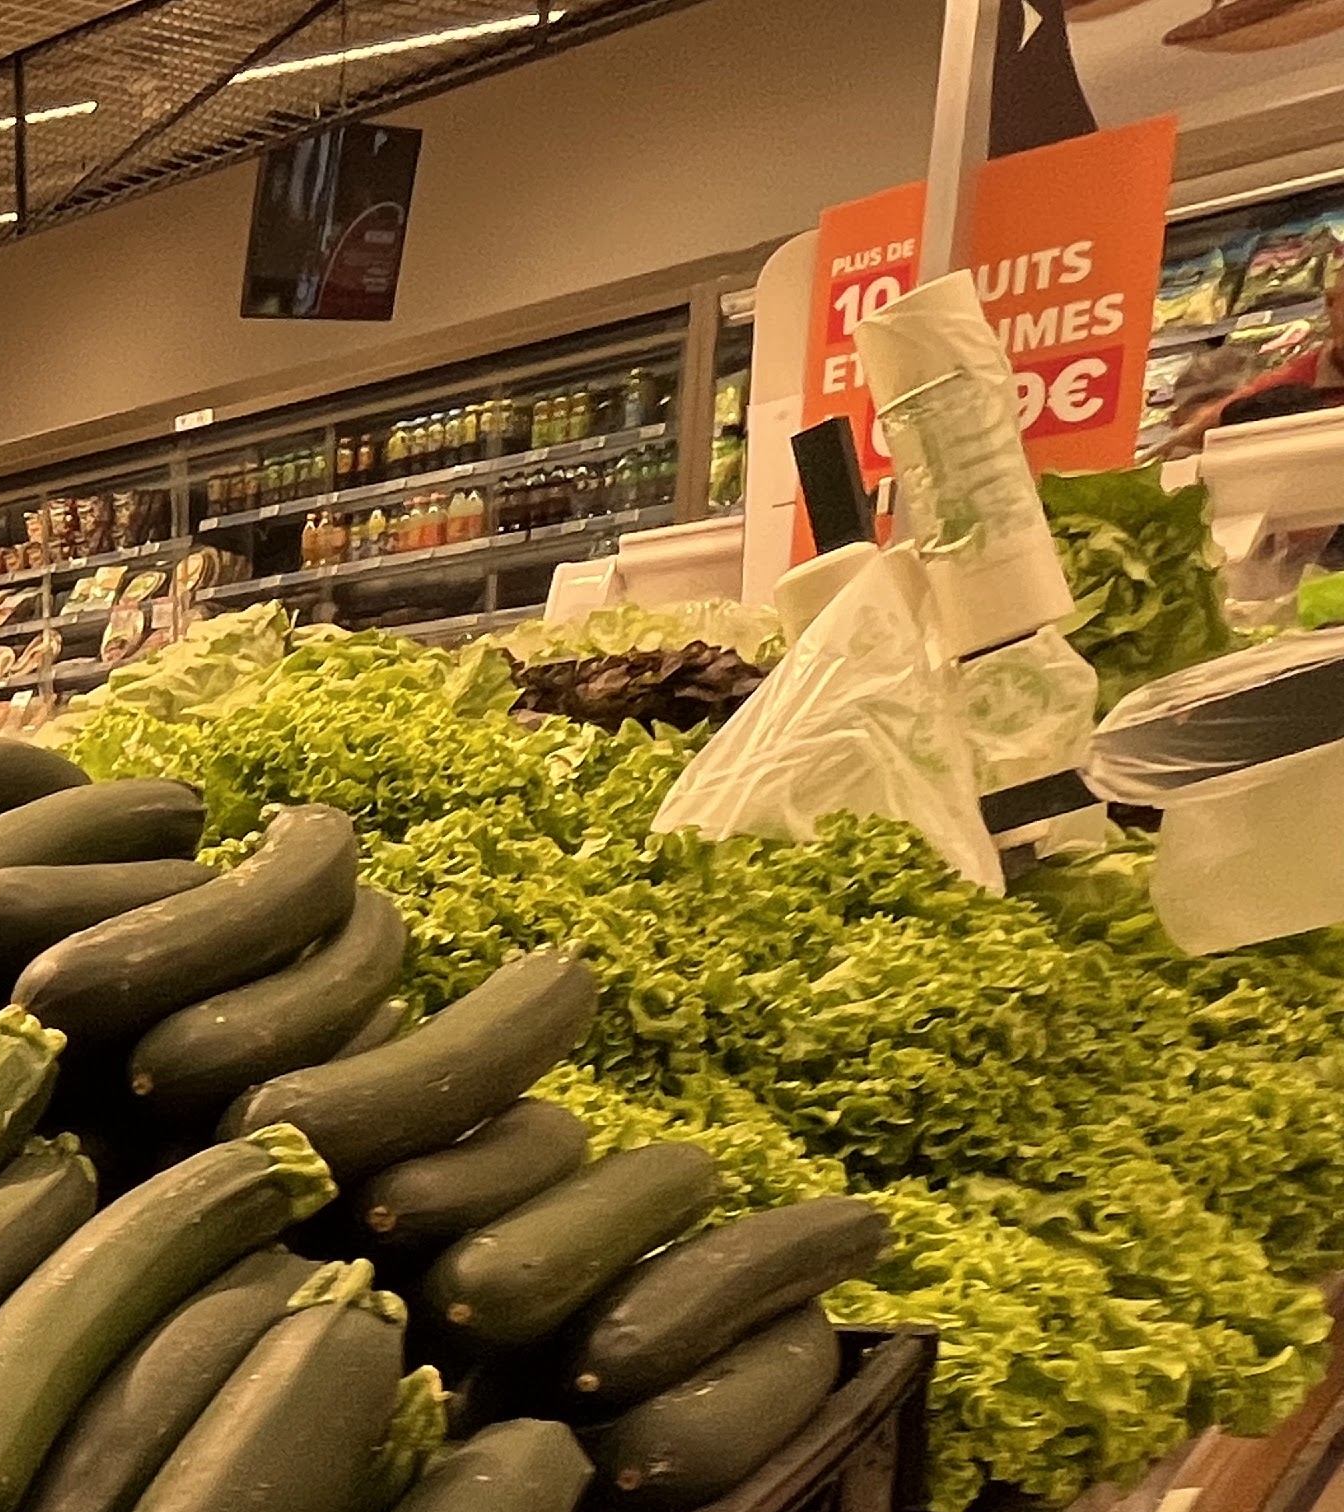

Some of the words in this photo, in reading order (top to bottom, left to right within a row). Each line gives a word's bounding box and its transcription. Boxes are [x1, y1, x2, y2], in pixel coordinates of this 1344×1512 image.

[831, 247, 882, 277] PLUS
[887, 239, 916, 262] DE
[975, 240, 1094, 304] UITS
